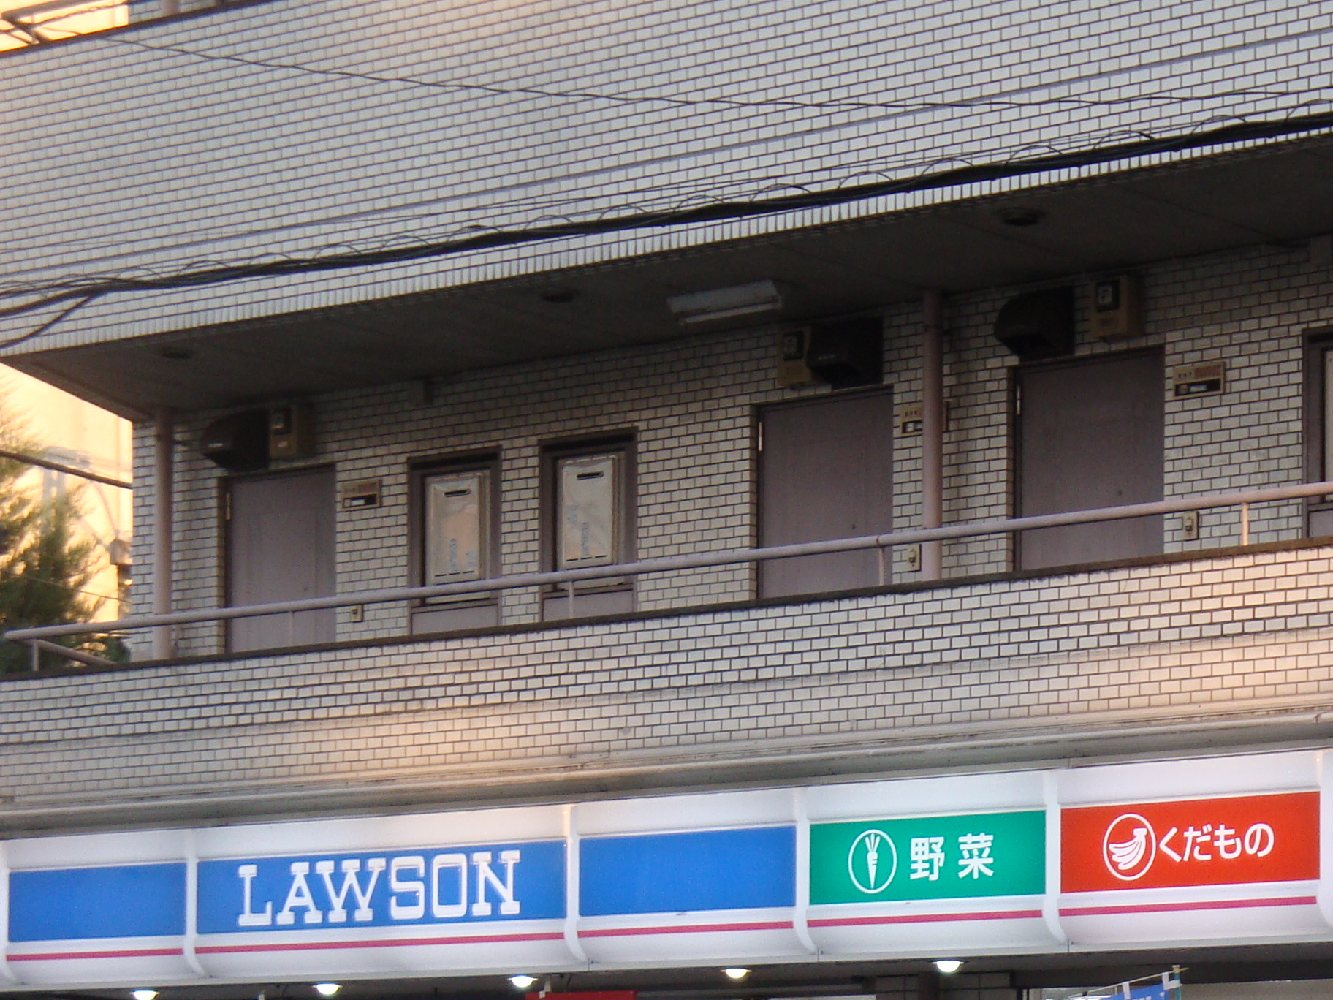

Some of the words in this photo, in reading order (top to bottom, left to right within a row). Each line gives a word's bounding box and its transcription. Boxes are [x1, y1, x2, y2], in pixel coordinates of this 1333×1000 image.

[909, 832, 994, 882] 野菜
[1159, 822, 1275, 863] くだもの
[236, 848, 521, 927] LAWSON
